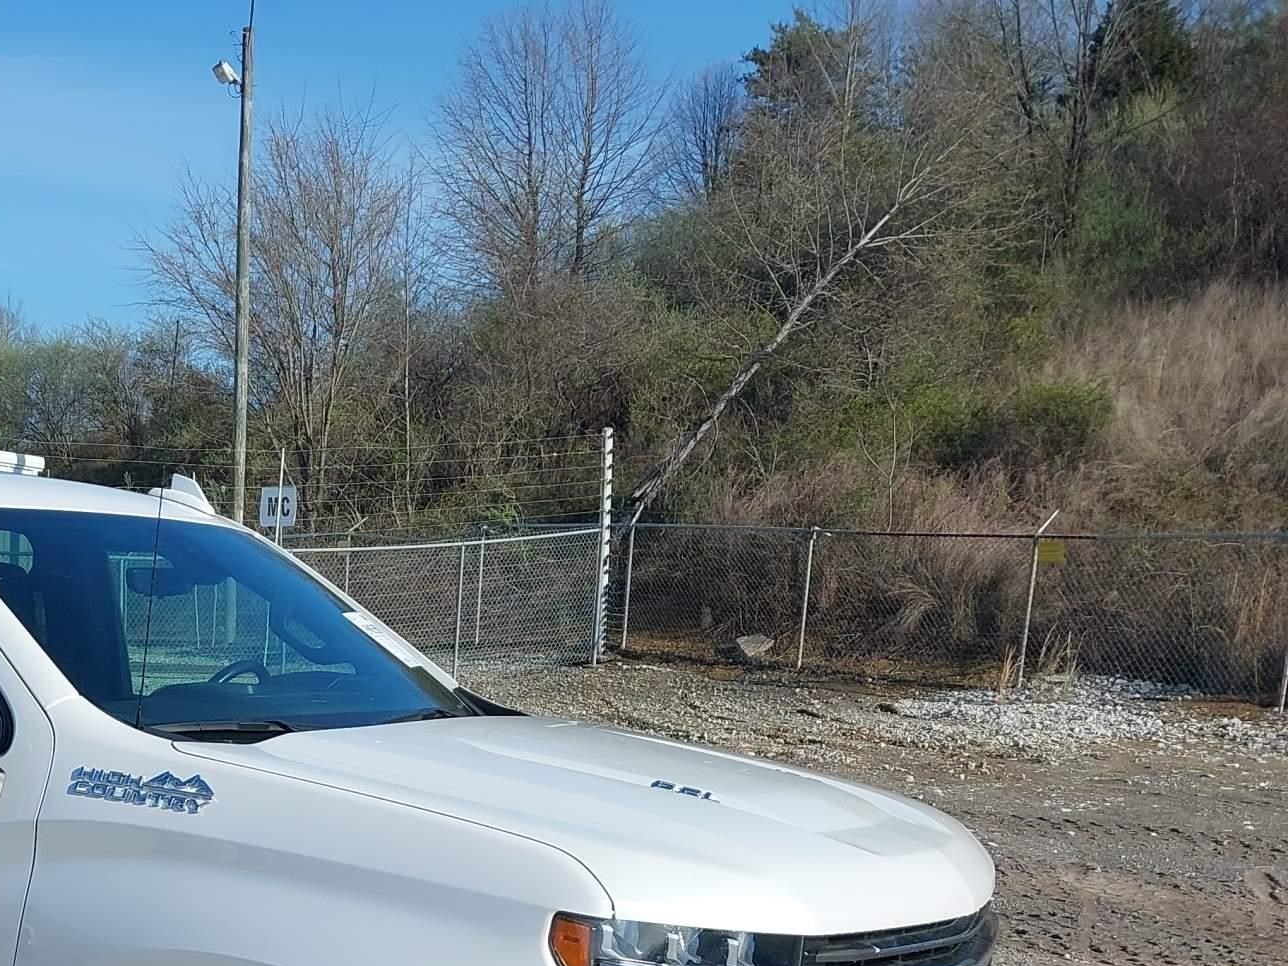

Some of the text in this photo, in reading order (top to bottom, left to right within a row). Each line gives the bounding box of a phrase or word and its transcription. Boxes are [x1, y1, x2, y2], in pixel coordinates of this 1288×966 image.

[267, 496, 290, 517] MC
[71, 766, 143, 788] HIGH
[66, 780, 211, 814] COUNTRY
